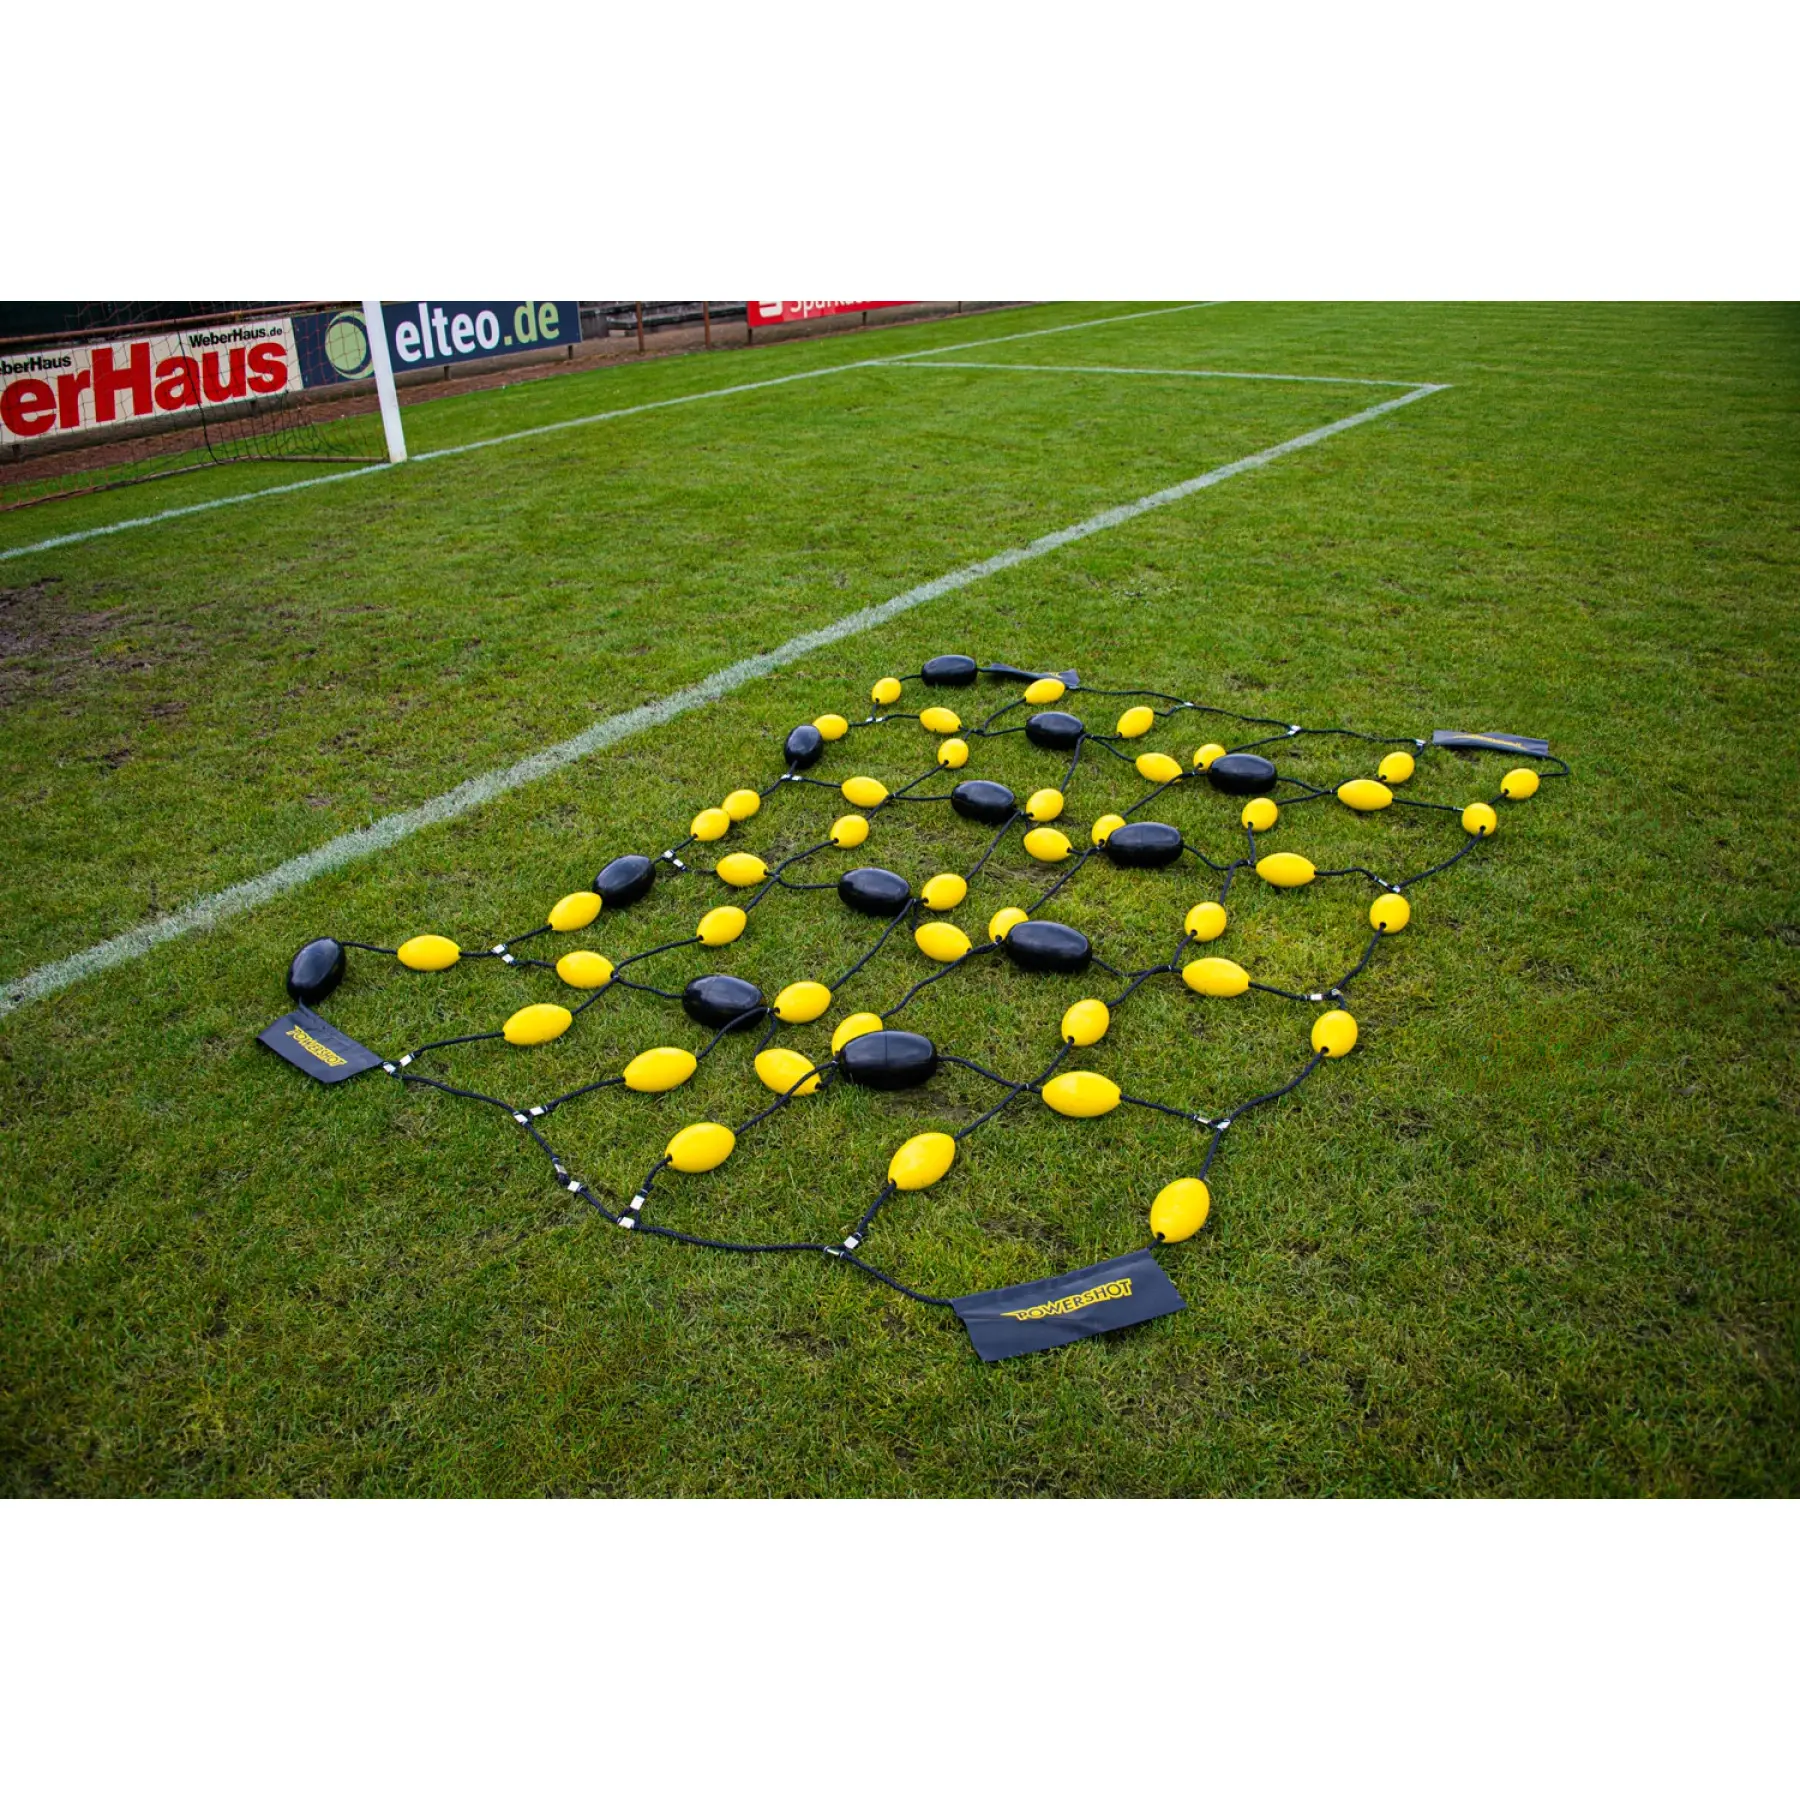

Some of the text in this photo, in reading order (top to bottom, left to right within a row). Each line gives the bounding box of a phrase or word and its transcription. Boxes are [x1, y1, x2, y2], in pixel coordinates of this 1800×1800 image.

[189, 326, 283, 348] WeberHaus.de
[395, 301, 560, 362] elteo.de
[0, 356, 72, 375] berHaus
[1003, 1277, 1132, 1321] POWERSHOT
